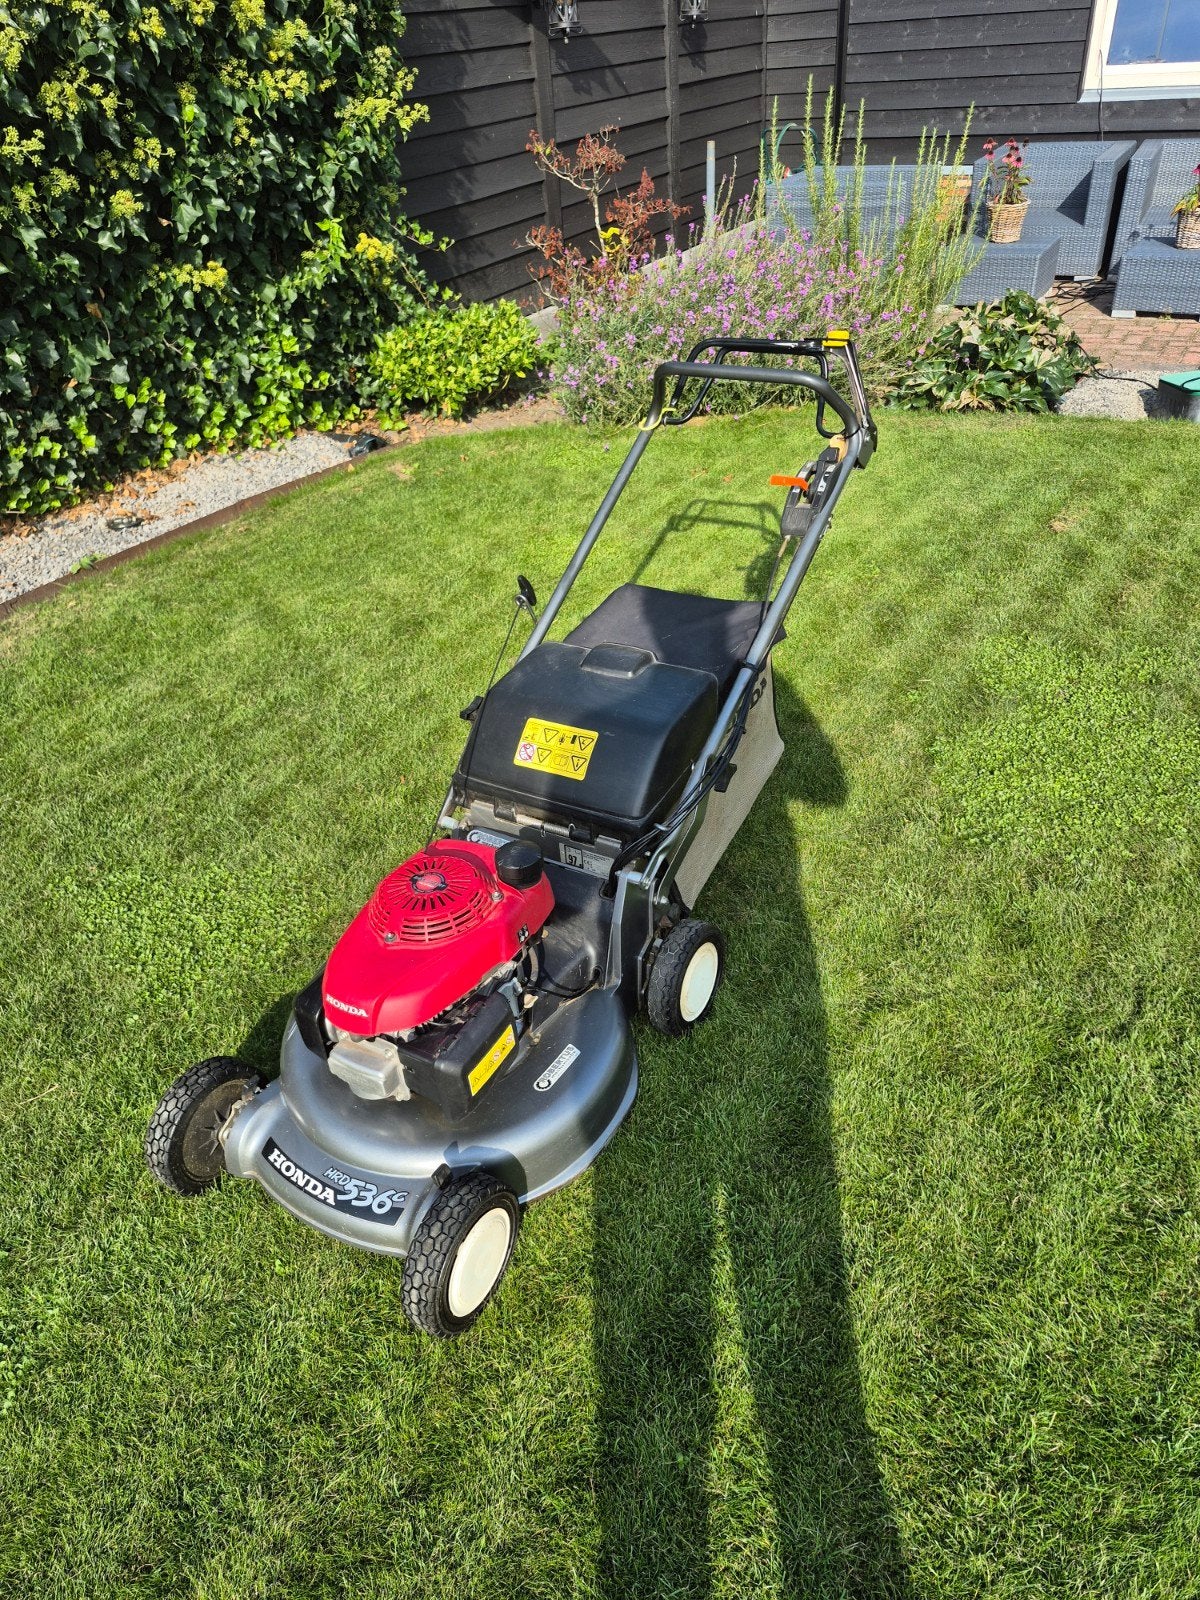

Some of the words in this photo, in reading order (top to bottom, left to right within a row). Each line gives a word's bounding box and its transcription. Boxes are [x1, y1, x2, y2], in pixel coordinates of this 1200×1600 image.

[568, 854, 577, 866] 97
[326, 993, 368, 1018] HONDA
[267, 1147, 336, 1206] HONDA
